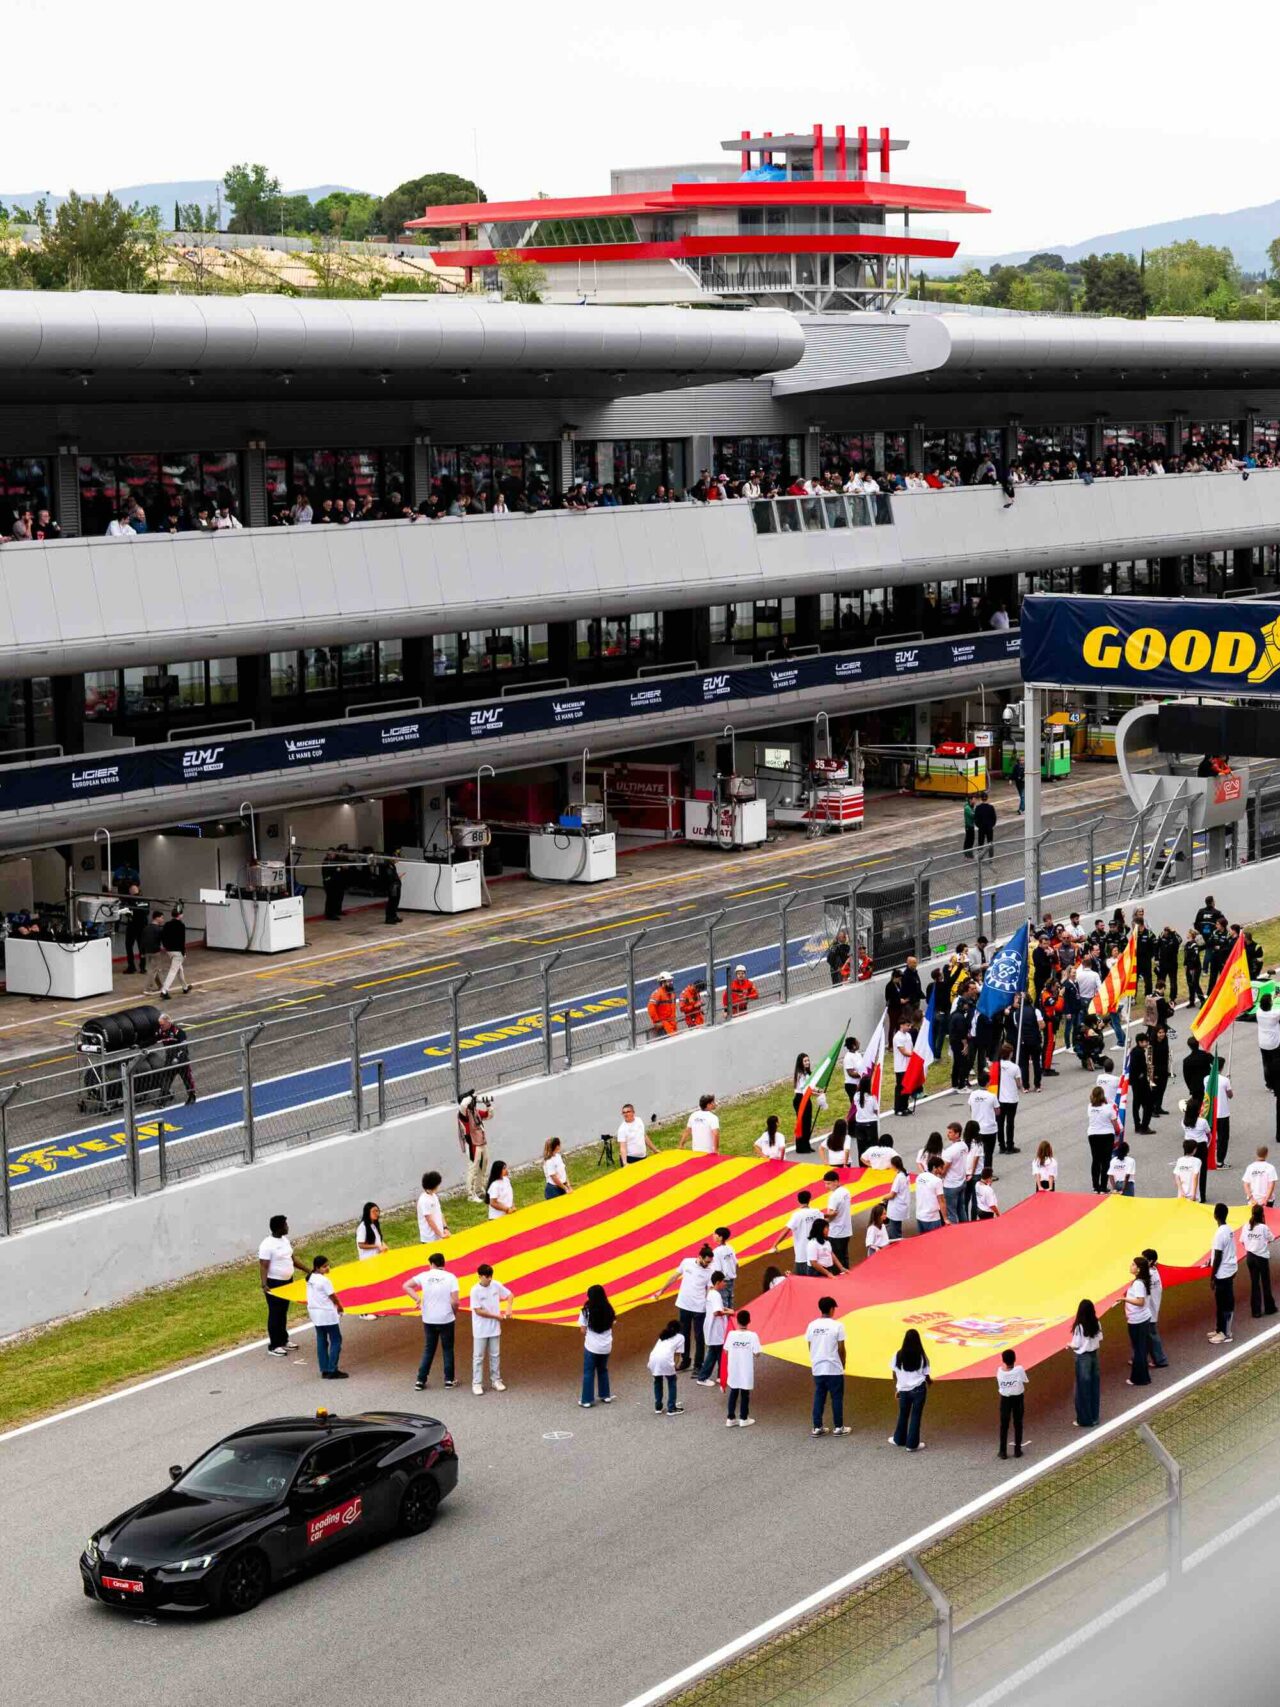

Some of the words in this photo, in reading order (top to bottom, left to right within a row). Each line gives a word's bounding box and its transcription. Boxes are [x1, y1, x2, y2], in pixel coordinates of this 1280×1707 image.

[631, 690, 661, 700] LIGIER
[381, 724, 419, 738] LIGIER
[296, 738, 325, 747] MICHELIN
[296, 751, 311, 759] MANS
[312, 750, 323, 758] CUP
[815, 760, 825, 769] 35
[72, 766, 119, 781] LIGIER
[72, 779, 100, 789] EUROPEAN
[100, 776, 119, 784] SERIES
[616, 781, 664, 793] ULTIMATE
[472, 831, 484, 842] 88
[692, 826, 735, 838] ULTMAT
[311, 1512, 340, 1533] Leading
[311, 1530, 323, 1541] car
